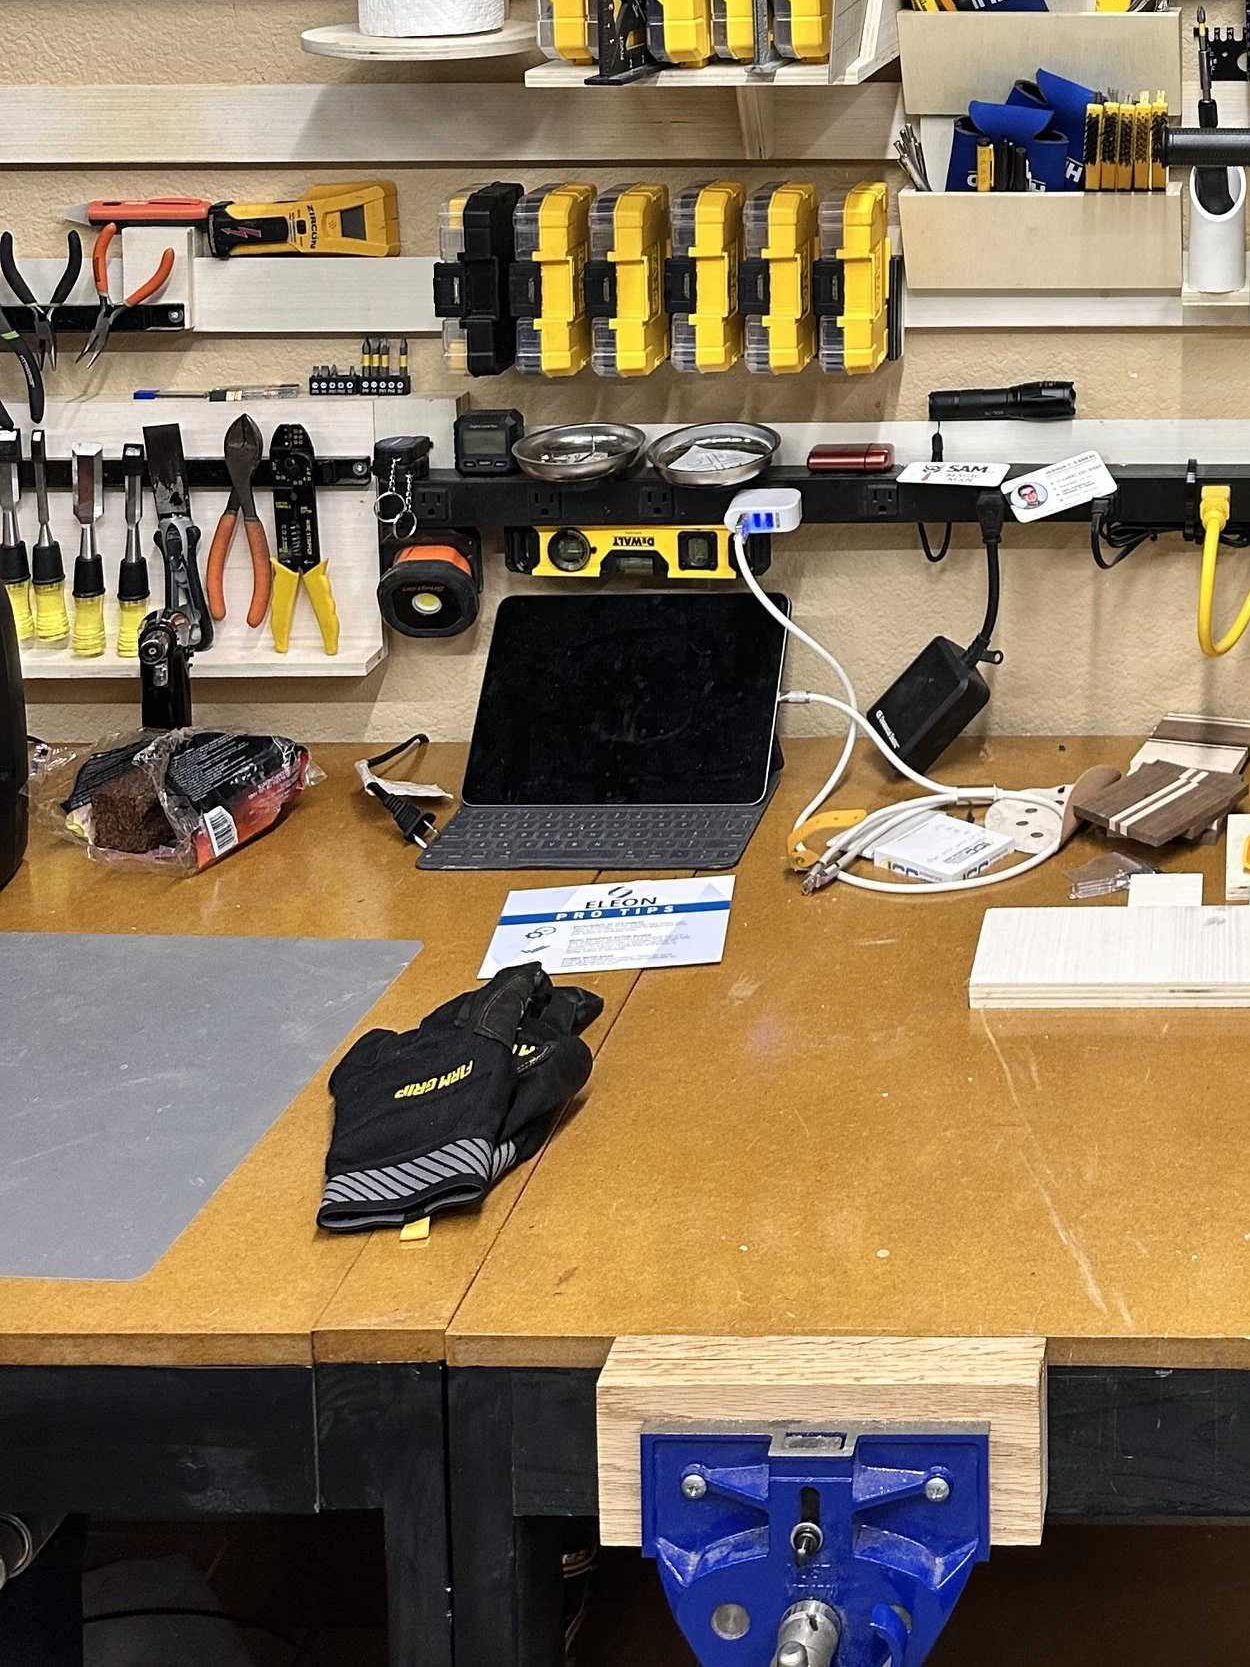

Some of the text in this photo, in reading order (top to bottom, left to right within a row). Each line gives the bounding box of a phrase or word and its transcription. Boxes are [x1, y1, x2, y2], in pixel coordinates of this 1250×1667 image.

[306, 204, 318, 249] ZIRCON
[946, 465, 989, 474] SAM
[612, 536, 655, 547] DEWALT
[585, 896, 657, 909] ELEON
[555, 905, 675, 921] PRO TIPS
[394, 1059, 474, 1099] FIRM GRIP
